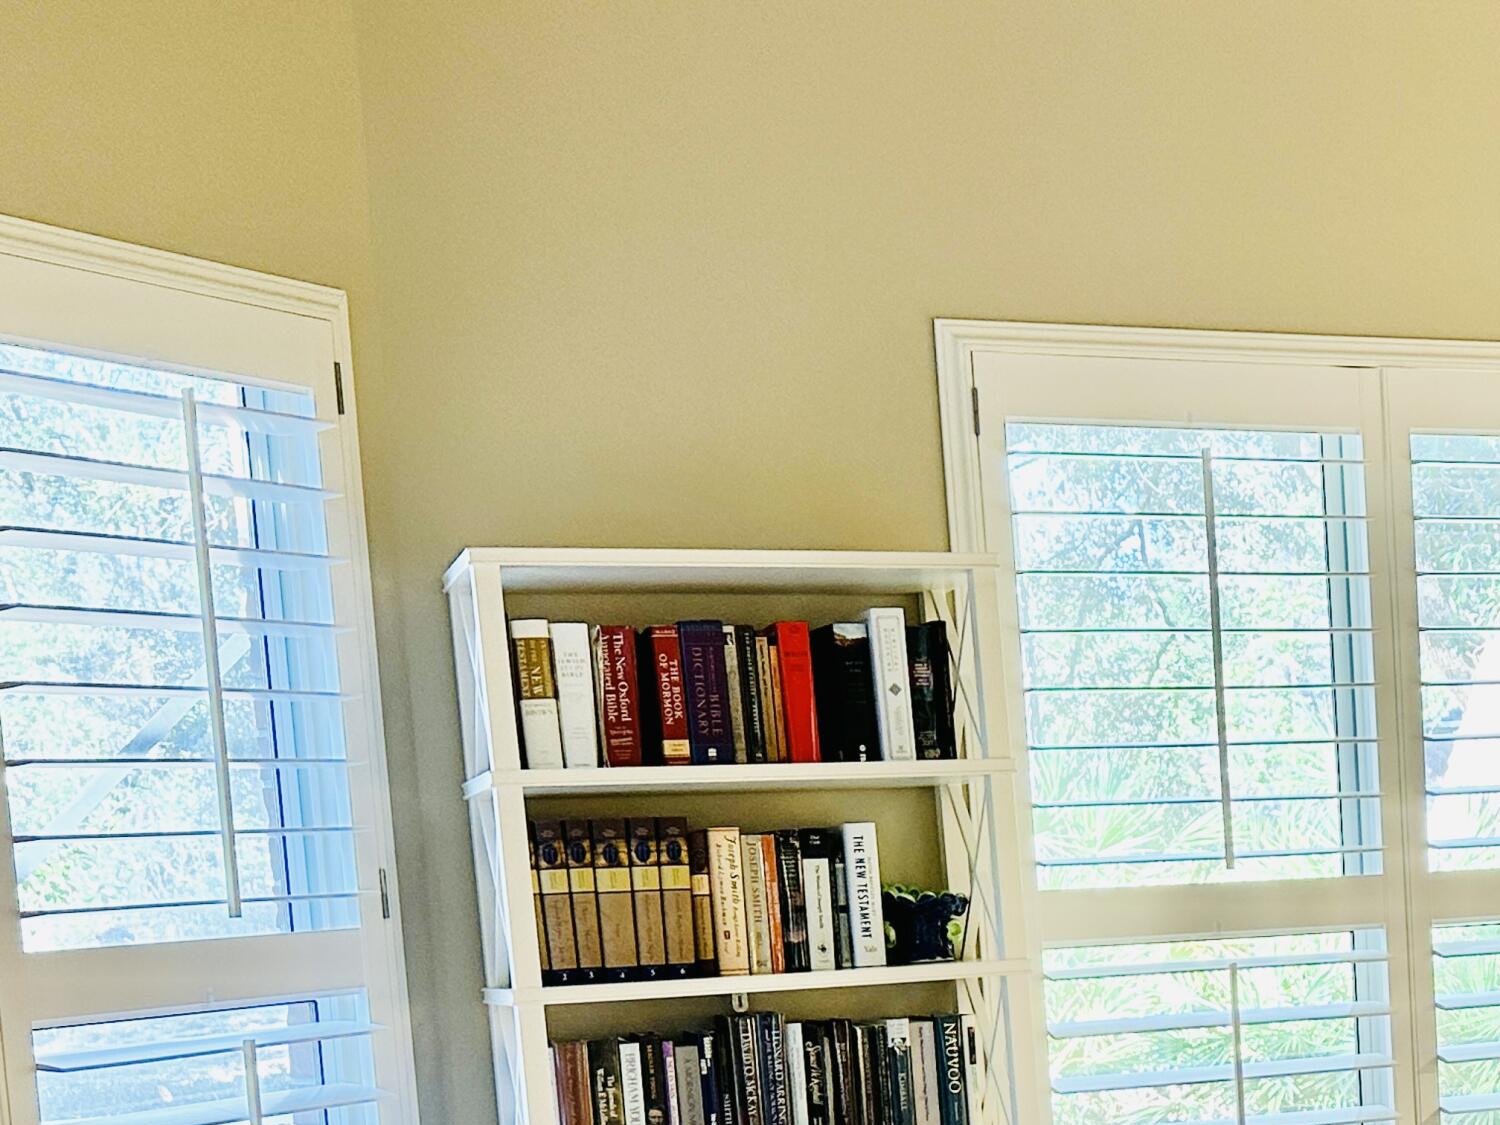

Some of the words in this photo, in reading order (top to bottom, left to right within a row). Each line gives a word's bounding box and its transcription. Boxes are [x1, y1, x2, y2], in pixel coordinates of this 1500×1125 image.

[612, 632, 623, 655] The
[658, 653, 668, 668] OF
[601, 635, 616, 693] Annotated
[615, 656, 626, 681] New
[669, 659, 679, 682] THE
[605, 694, 619, 723] Bible
[617, 682, 633, 722] Oxford
[660, 673, 675, 726] MORMON
[671, 686, 684, 719] BOOK
[691, 647, 709, 736] DICTIONARY
[709, 694, 723, 737] BIBLE
[723, 836, 739, 871] Joseph
[852, 835, 864, 853] THE
[746, 842, 762, 883] JOSEPH
[855, 858, 867, 878] NEW
[730, 872, 742, 905] Smith
[750, 887, 762, 924] SMITH
[856, 884, 873, 939] TESTAMENT
[741, 1033, 753, 1063] DAVID
[944, 1022, 962, 1093] NAUVOO
[624, 1053, 639, 1103] BRIGHAM
[898, 1072, 909, 1111] KIMBALL
[724, 1093, 733, 1125] SMITH
